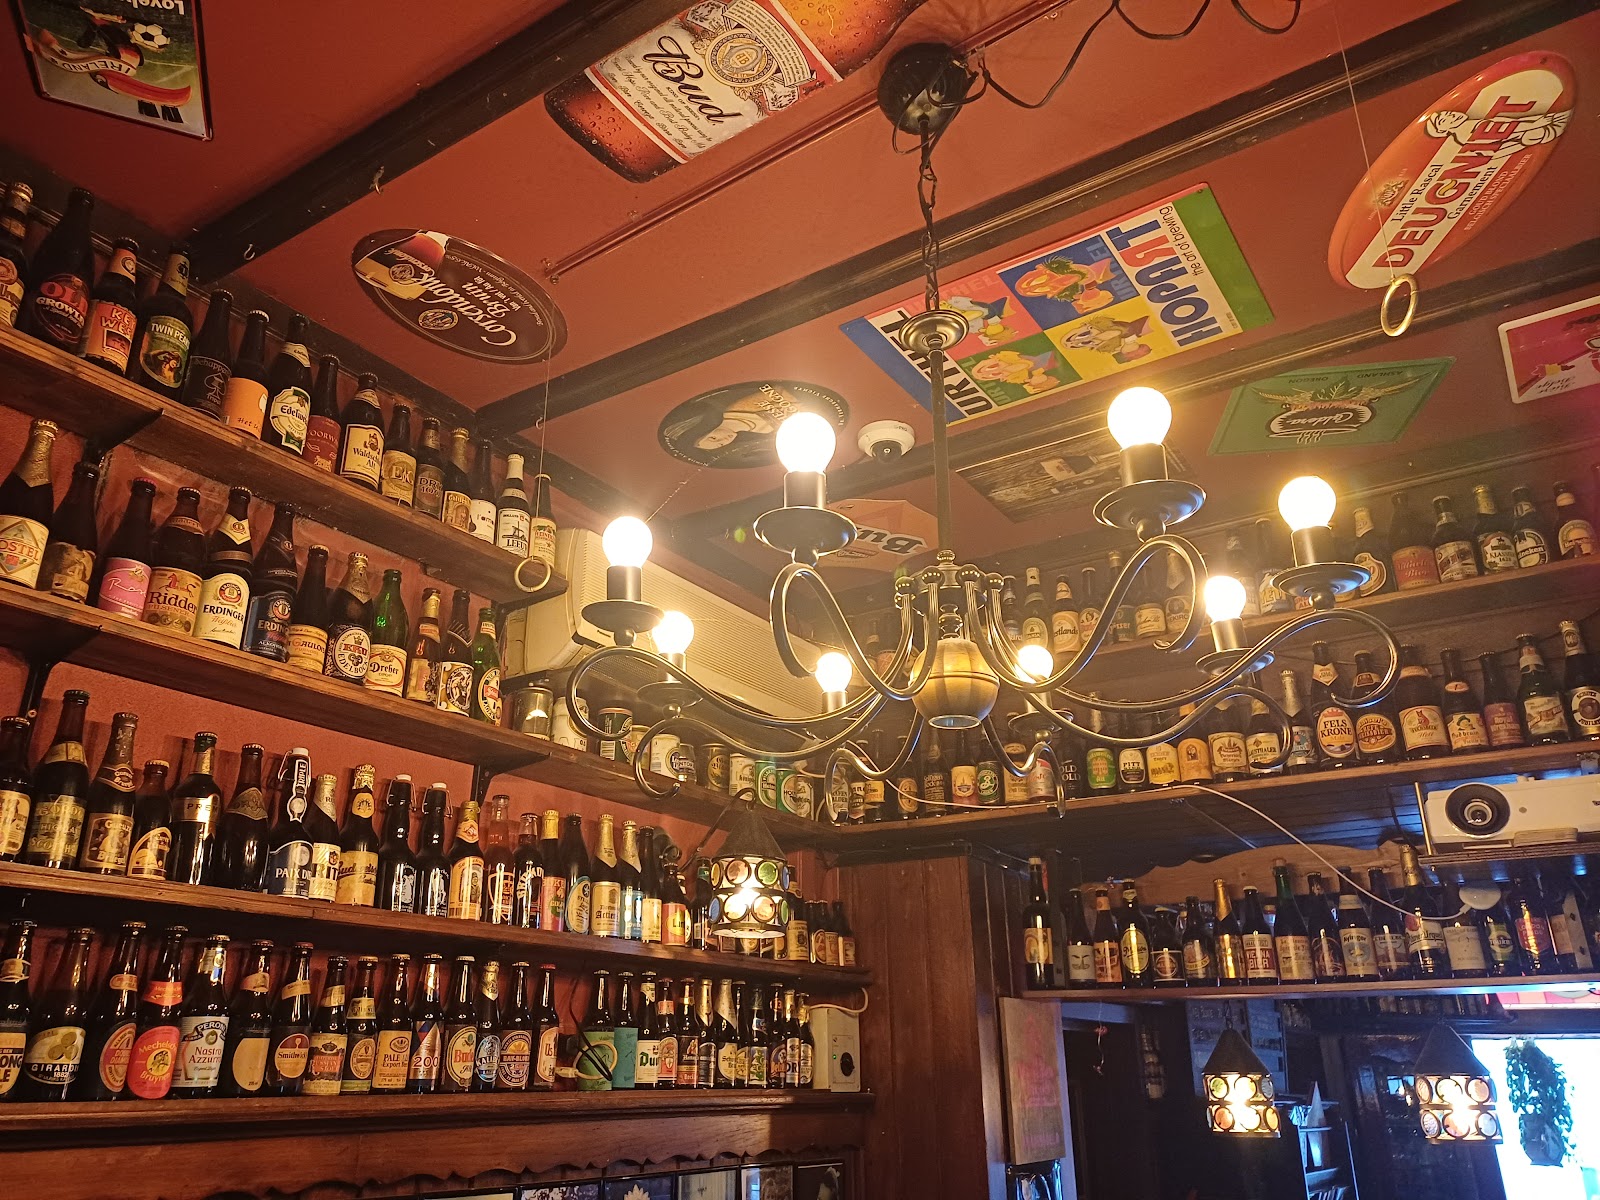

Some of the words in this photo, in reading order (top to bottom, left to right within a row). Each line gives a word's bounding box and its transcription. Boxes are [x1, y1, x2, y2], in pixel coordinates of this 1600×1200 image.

[120, 0, 184, 15] Lovel
[62, 59, 131, 74] IRELAND
[1372, 96, 1537, 268] DEUGNIET
[1391, 191, 1417, 222] Little
[1414, 163, 1443, 196] Rascal
[1446, 165, 1499, 220] Garnement
[1158, 205, 1185, 243] brewing
[1175, 242, 1190, 252] of
[1182, 249, 1197, 262] art
[1189, 261, 1204, 276] the
[461, 281, 512, 319] Bruin
[415, 271, 518, 347] Corsendonk
[101, 316, 132, 337] WES
[151, 322, 173, 336] TWIN
[1288, 375, 1330, 385] OREGON
[0, 538, 39, 562] OSTEL
[148, 591, 198, 614] Ridder
[203, 604, 245, 623] ERDINGER
[369, 660, 400, 676] Dreher
[1323, 719, 1348, 728] FELS
[1319, 727, 1352, 739] KRONE
[275, 867, 300, 879] PAIX
[194, 1045, 222, 1057] Nastro
[0, 1054, 23, 1069] ONG
